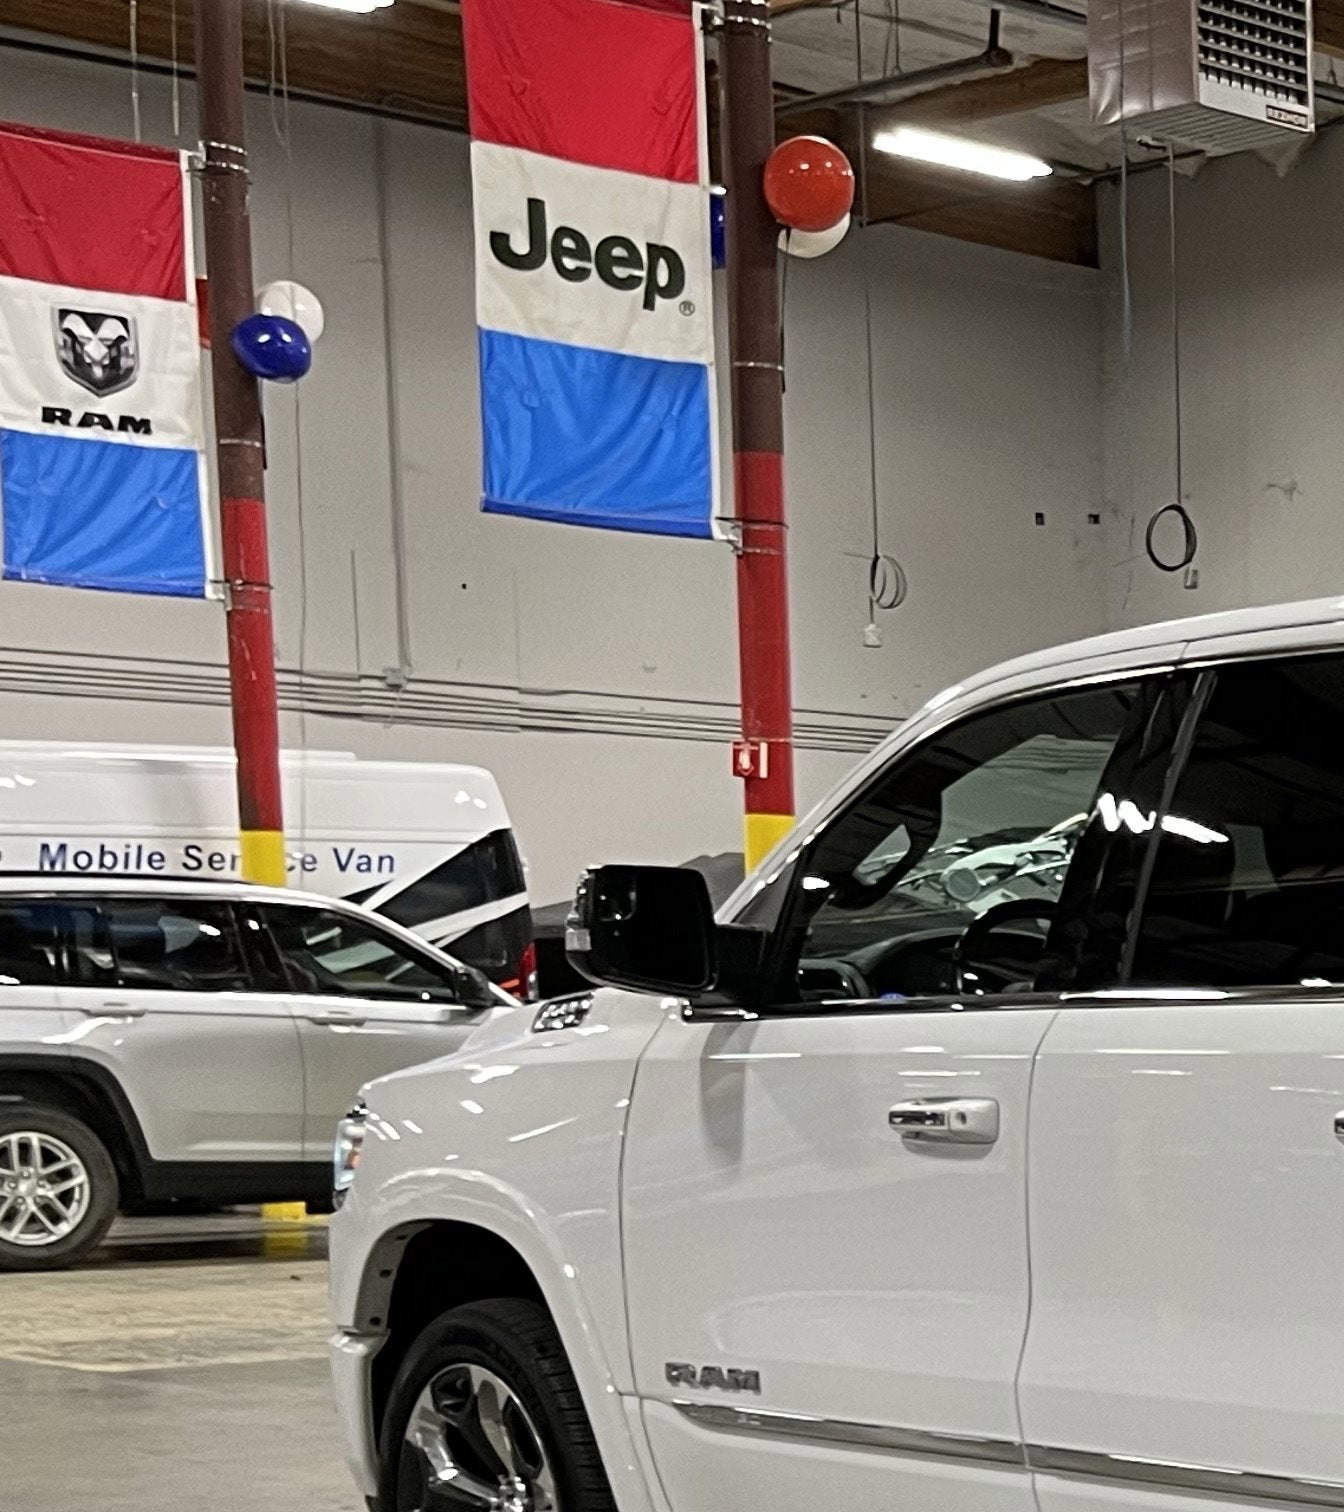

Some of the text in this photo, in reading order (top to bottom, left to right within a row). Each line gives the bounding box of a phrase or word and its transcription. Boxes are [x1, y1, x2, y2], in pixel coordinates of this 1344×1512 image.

[489, 197, 686, 311] Jeep
[41, 406, 153, 436] RAM
[39, 843, 395, 874] Mobile Serce Van
[665, 1362, 762, 1396] RAM
